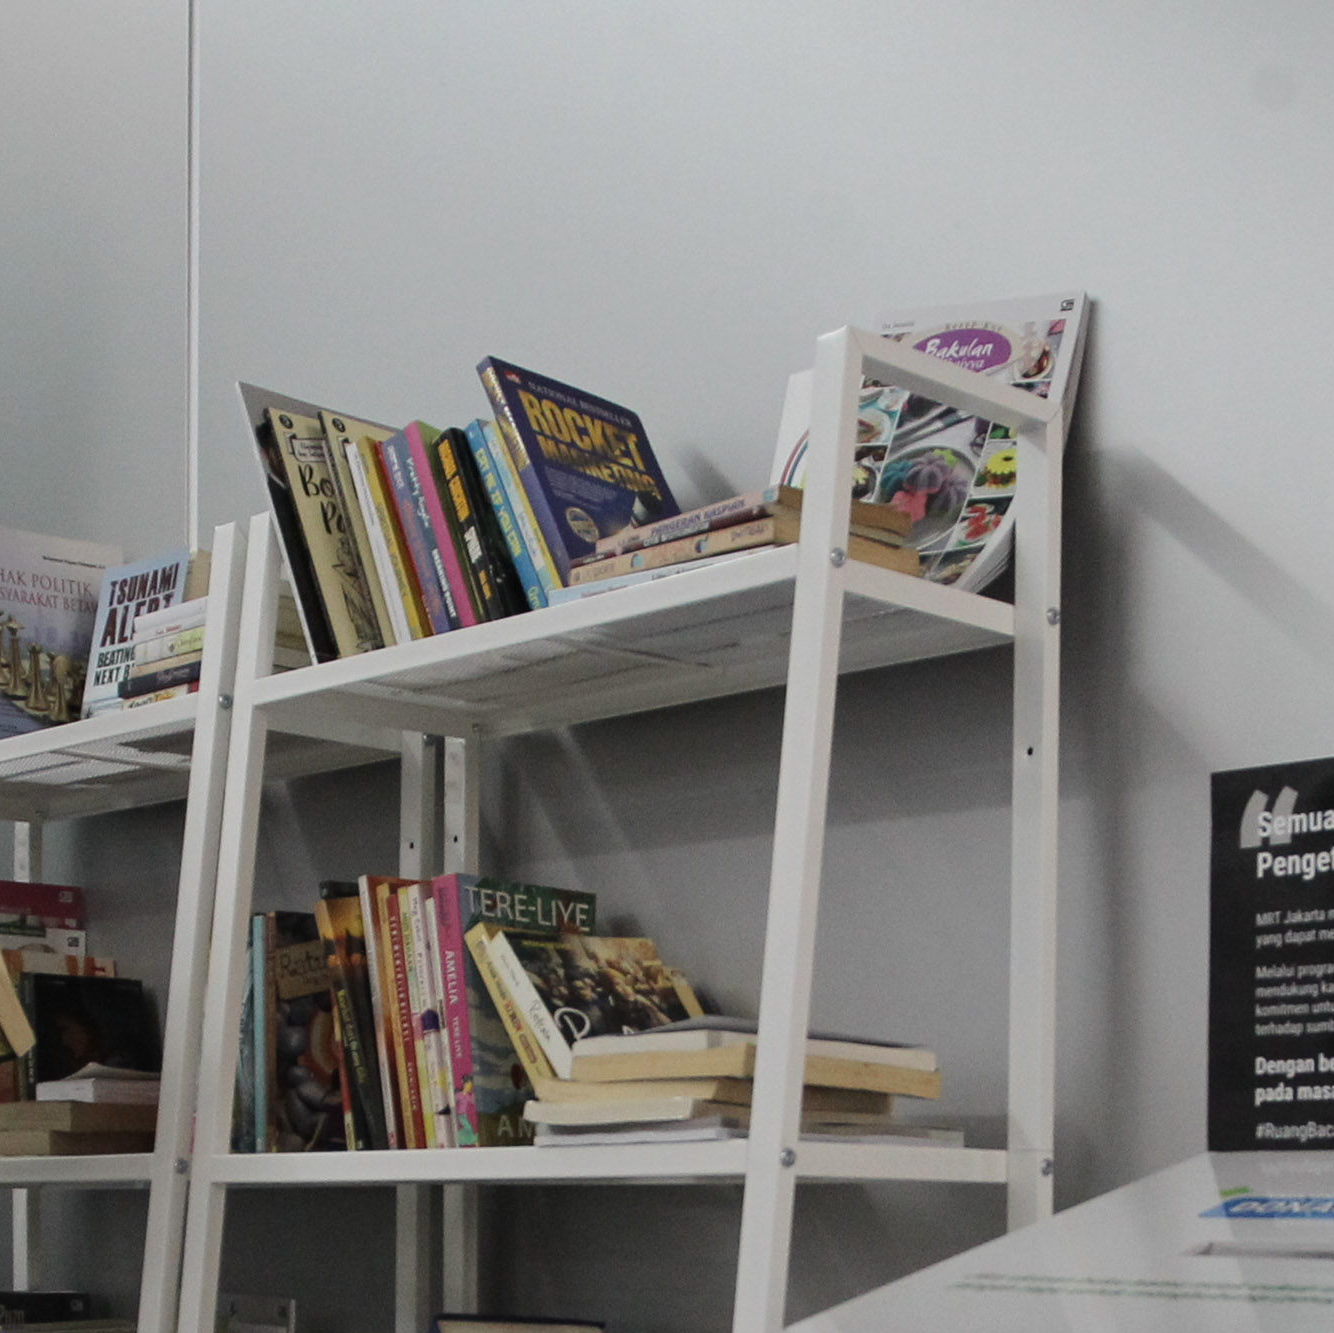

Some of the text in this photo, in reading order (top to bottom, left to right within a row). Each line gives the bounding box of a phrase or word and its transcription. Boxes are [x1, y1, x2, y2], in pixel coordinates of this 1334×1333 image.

[925, 338, 994, 359] Bakulan
[518, 390, 646, 473] ROCKET
[32, 574, 94, 596] POLITIK
[108, 563, 180, 607] TSUNAMI
[93, 668, 121, 686] NEXT
[1255, 911, 1282, 926] MRT
[1284, 909, 1325, 924] Jakarta
[1255, 933, 1282, 949] yang
[1284, 929, 1316, 945] dapat
[1255, 964, 1295, 979] Melalui
[1255, 983, 1319, 998] mendukung
[1255, 1055, 1315, 1078] Dengan
[1255, 1082, 1294, 1106] pada
